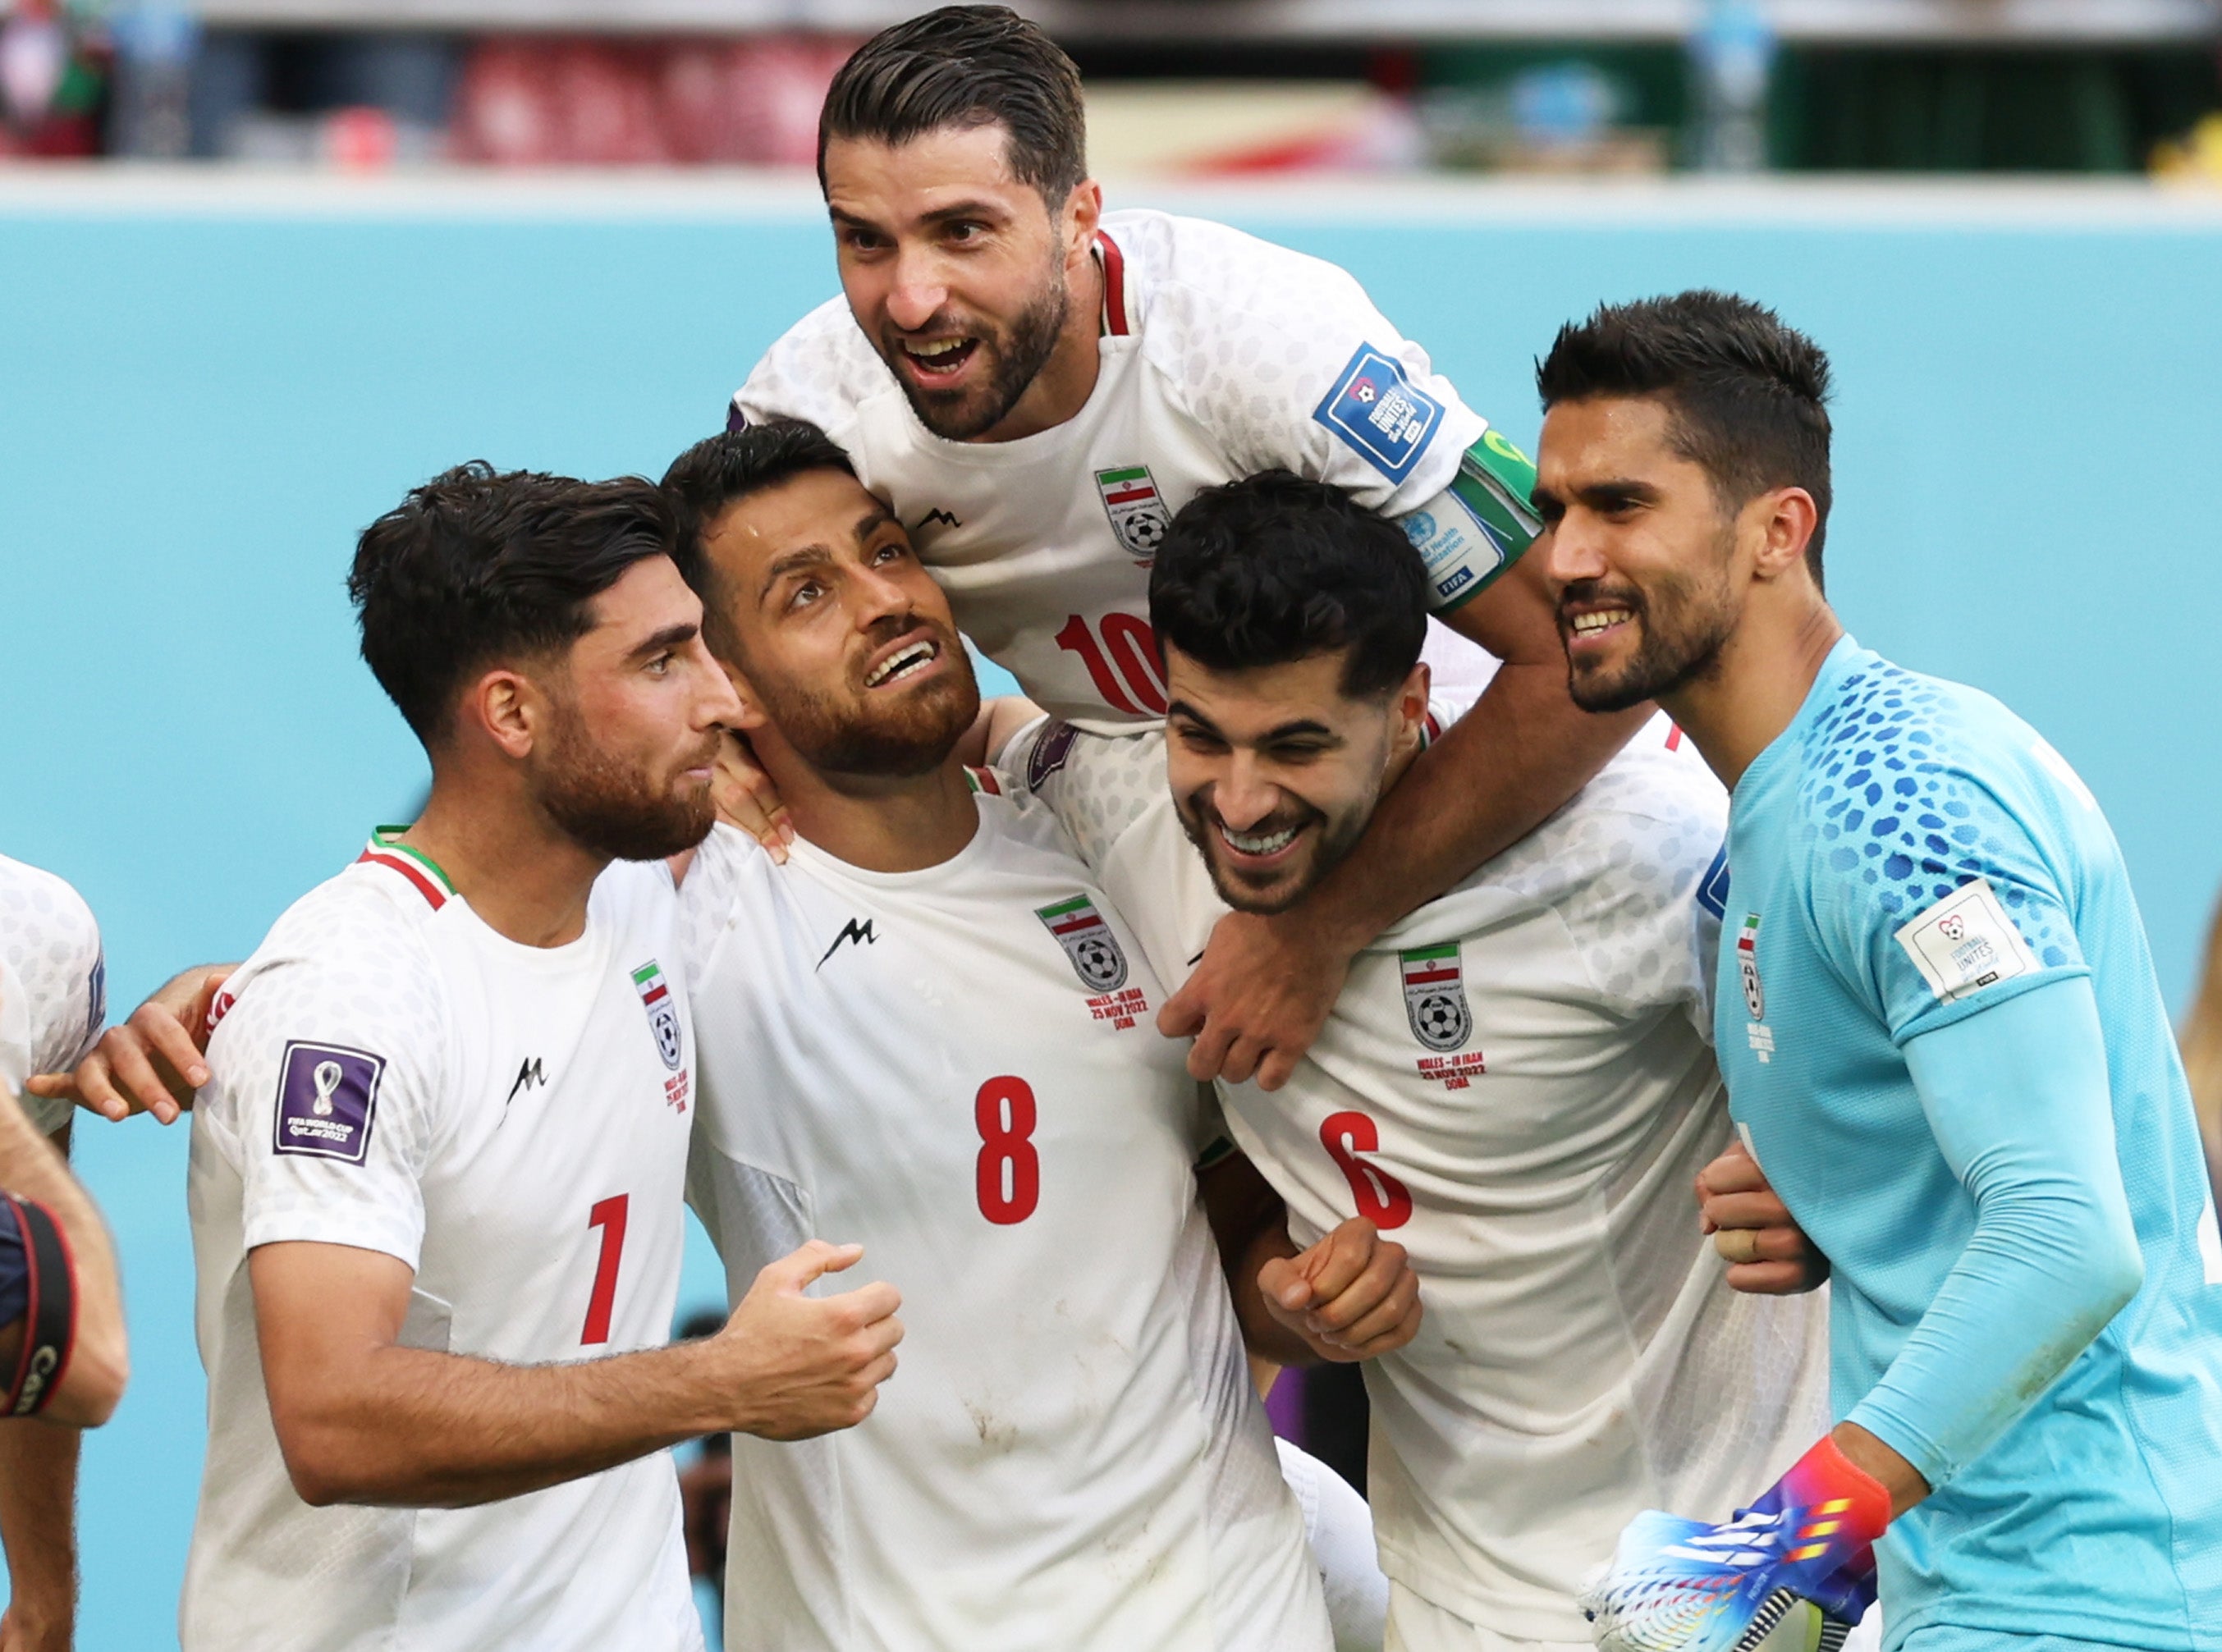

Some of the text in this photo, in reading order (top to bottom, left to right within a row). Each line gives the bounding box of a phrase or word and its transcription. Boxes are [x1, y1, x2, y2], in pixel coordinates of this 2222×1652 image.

[1377, 396, 1407, 433] UNITES
[1430, 528, 1459, 551] Health
[1424, 535, 1464, 569] nization
[1441, 572, 1468, 593] FIFA
[1054, 612, 1168, 715] 10
[1957, 942, 1994, 971] UNITES
[1091, 1000, 1148, 1019] 25 NOV 2022
[1113, 1016, 1136, 1031] DOHA
[1417, 1056, 1444, 1070] WALES
[1463, 1051, 1482, 1065] IRAN
[1457, 1064, 1487, 1077] 2022
[1445, 1077, 1470, 1091] DOHA
[287, 1117, 354, 1133] FIFA WORLD CUP
[974, 1075, 1039, 1224] 8
[1319, 1110, 1413, 1230] 6
